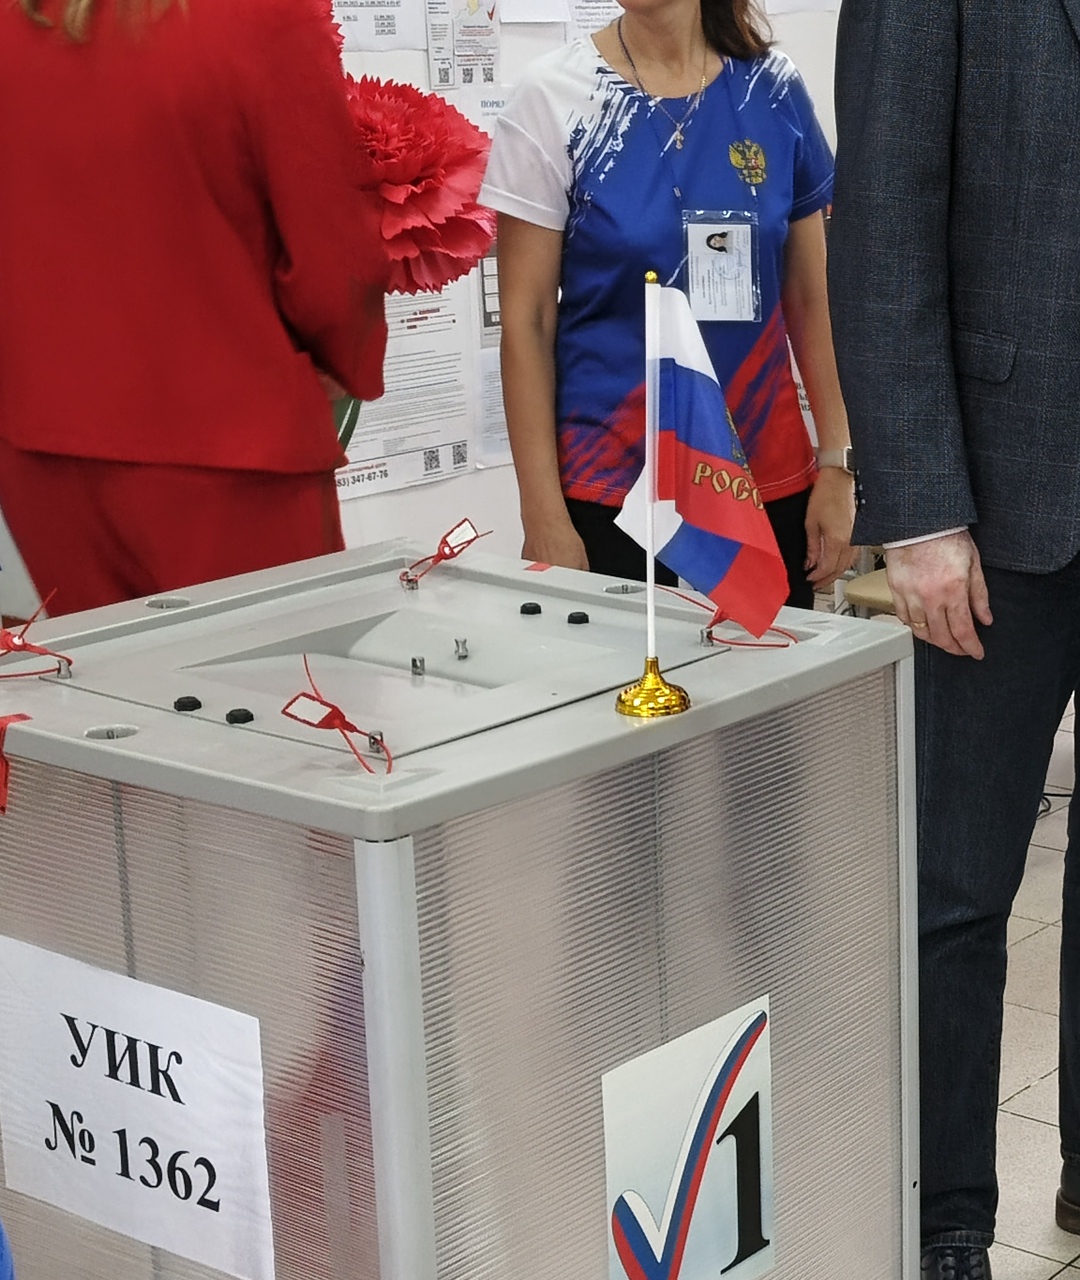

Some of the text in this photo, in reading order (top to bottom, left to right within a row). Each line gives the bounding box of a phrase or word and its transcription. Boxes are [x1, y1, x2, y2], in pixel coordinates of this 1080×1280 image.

[60, 1012, 186, 1106] УИК
[44, 1099, 222, 1213] № 1362
[716, 1091, 771, 1276] 1
